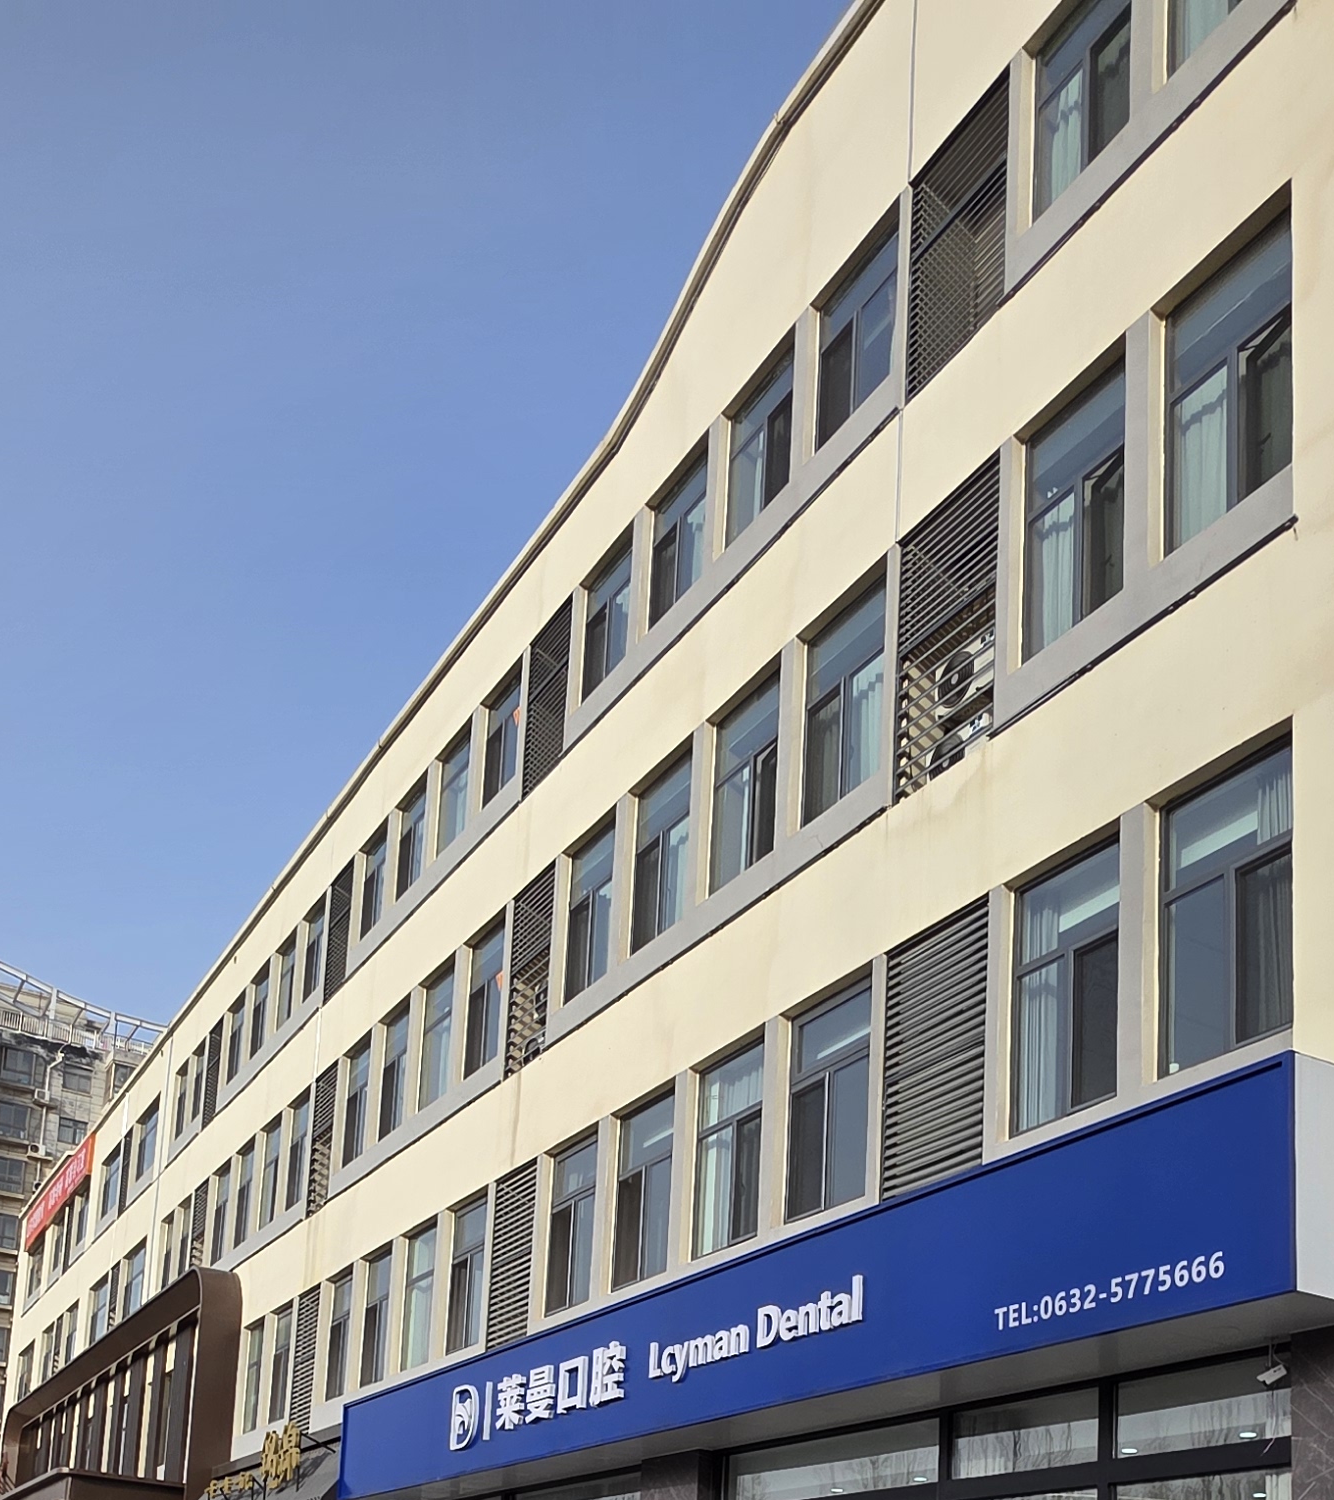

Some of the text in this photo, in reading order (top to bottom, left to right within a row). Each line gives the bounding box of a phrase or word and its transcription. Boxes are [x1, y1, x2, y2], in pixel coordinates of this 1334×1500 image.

[756, 1274, 864, 1349] Dental
[994, 1251, 1225, 1331] TEL:0632-5775666
[495, 1341, 627, 1430] 莱曼口腔
